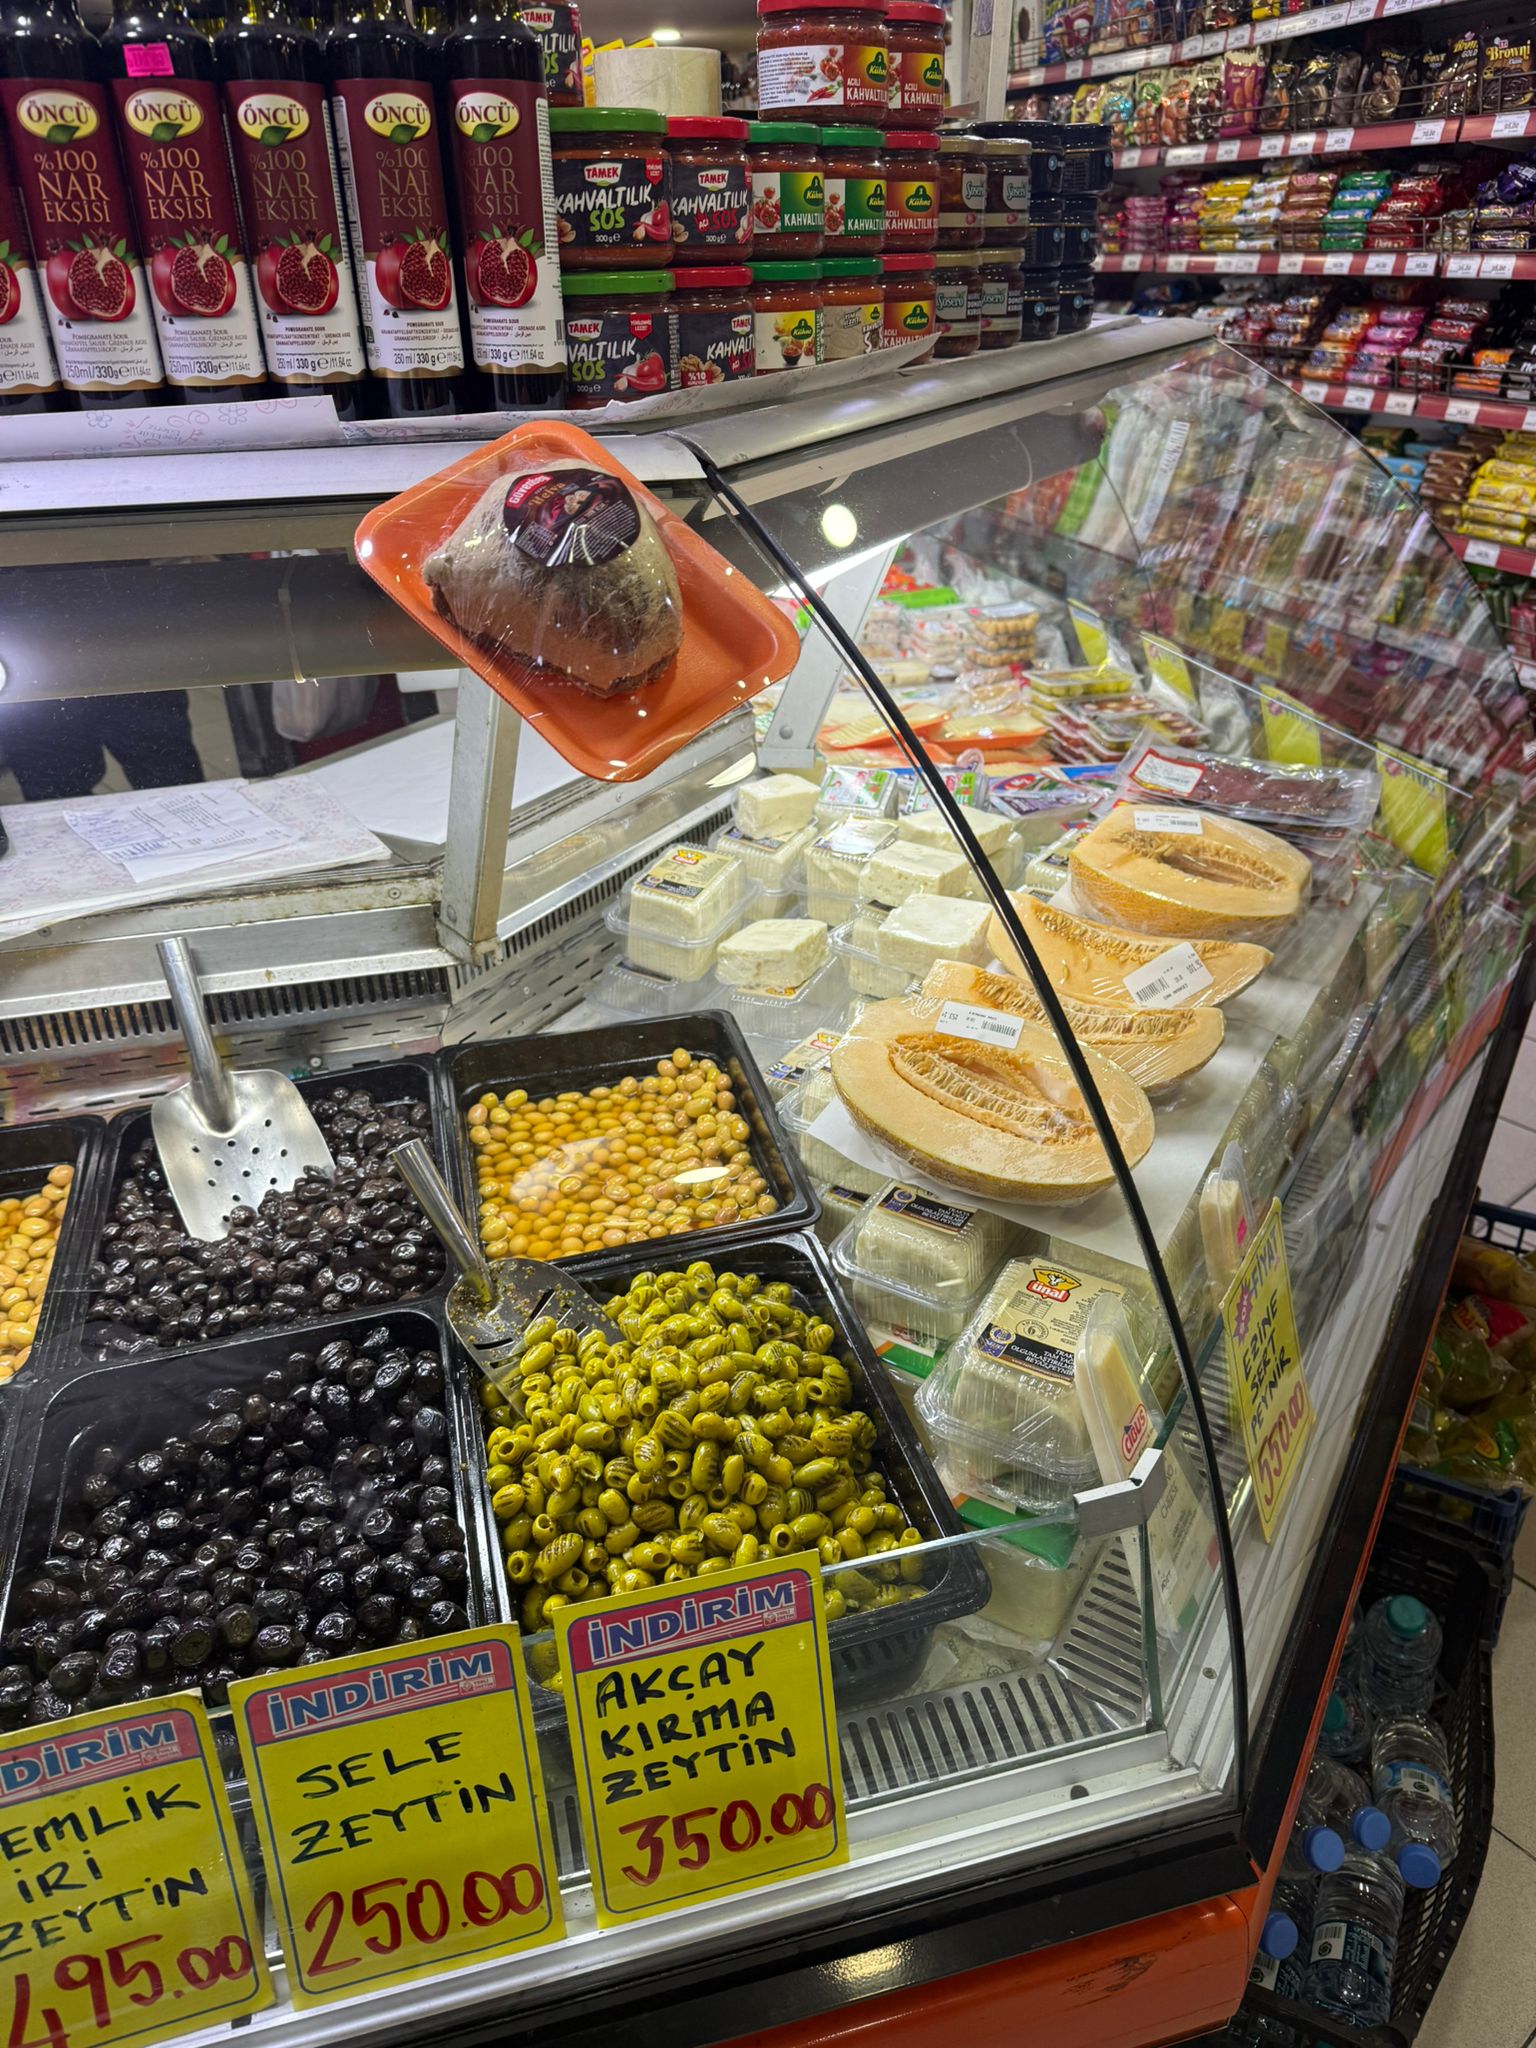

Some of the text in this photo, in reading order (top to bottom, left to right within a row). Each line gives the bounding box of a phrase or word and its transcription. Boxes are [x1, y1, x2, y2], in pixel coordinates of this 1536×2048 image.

[524, 11, 554, 24] TAMEK
[1486, 40, 1531, 61] Browni
[27, 100, 90, 124] ÖNCÜ
[134, 99, 193, 123] ÖNCÜ
[243, 103, 300, 126] ÖNCÜ
[372, 101, 426, 125] ÖNCÜ
[459, 102, 511, 124] ÖNCÜ
[34, 149, 97, 172] %100
[141, 147, 200, 169] %100
[250, 150, 306, 171] %100
[376, 147, 429, 168] %100
[144, 169, 214, 198] NAR
[253, 171, 319, 199] NAR
[586, 166, 620, 179] TAMEK
[699, 172, 727, 184] TAMEK
[38, 171, 111, 201] NAR
[555, 183, 653, 214] KAHVALTILIK
[44, 199, 112, 225] EKŞİSİ
[149, 197, 214, 223] EKŞİSİ
[257, 198, 319, 223] EKŞİSİ
[672, 190, 749, 216] KAHVALTILIK
[589, 206, 626, 232] SOS
[711, 209, 738, 229] SOS
[885, 217, 932, 230] KAHVALTILIK
[568, 322, 600, 334] TAMEK
[416, 353, 430, 365] 330
[490, 349, 503, 360] 330
[567, 337, 637, 364] VALTILIK
[572, 359, 606, 382] SOS
[1033, 1282, 1066, 1300] ünal
[1043, 1350, 1060, 1361] TAM
[1250, 1334, 1277, 1405] SERT
[1123, 1408, 1147, 1454] CIBUS
[587, 1582, 796, 1663] İNDİRİM
[596, 1640, 765, 1718] AKÇAY
[266, 1651, 495, 1735] İNDİRİM
[600, 1690, 775, 1761] KIRMA
[0, 1720, 178, 1793] DİRİM
[295, 1731, 464, 1799] SELE
[601, 1727, 796, 1805] ZEYTİN
[0, 1783, 201, 1862] EMLİK
[291, 1772, 517, 1865] ZEYTİN
[618, 1782, 835, 1887] 350.00
[13, 1849, 104, 1904] İRİ
[0, 1866, 208, 1962] ZEYTİN
[304, 1861, 545, 1978] 250.00
[8, 1934, 255, 2048] 495.00
